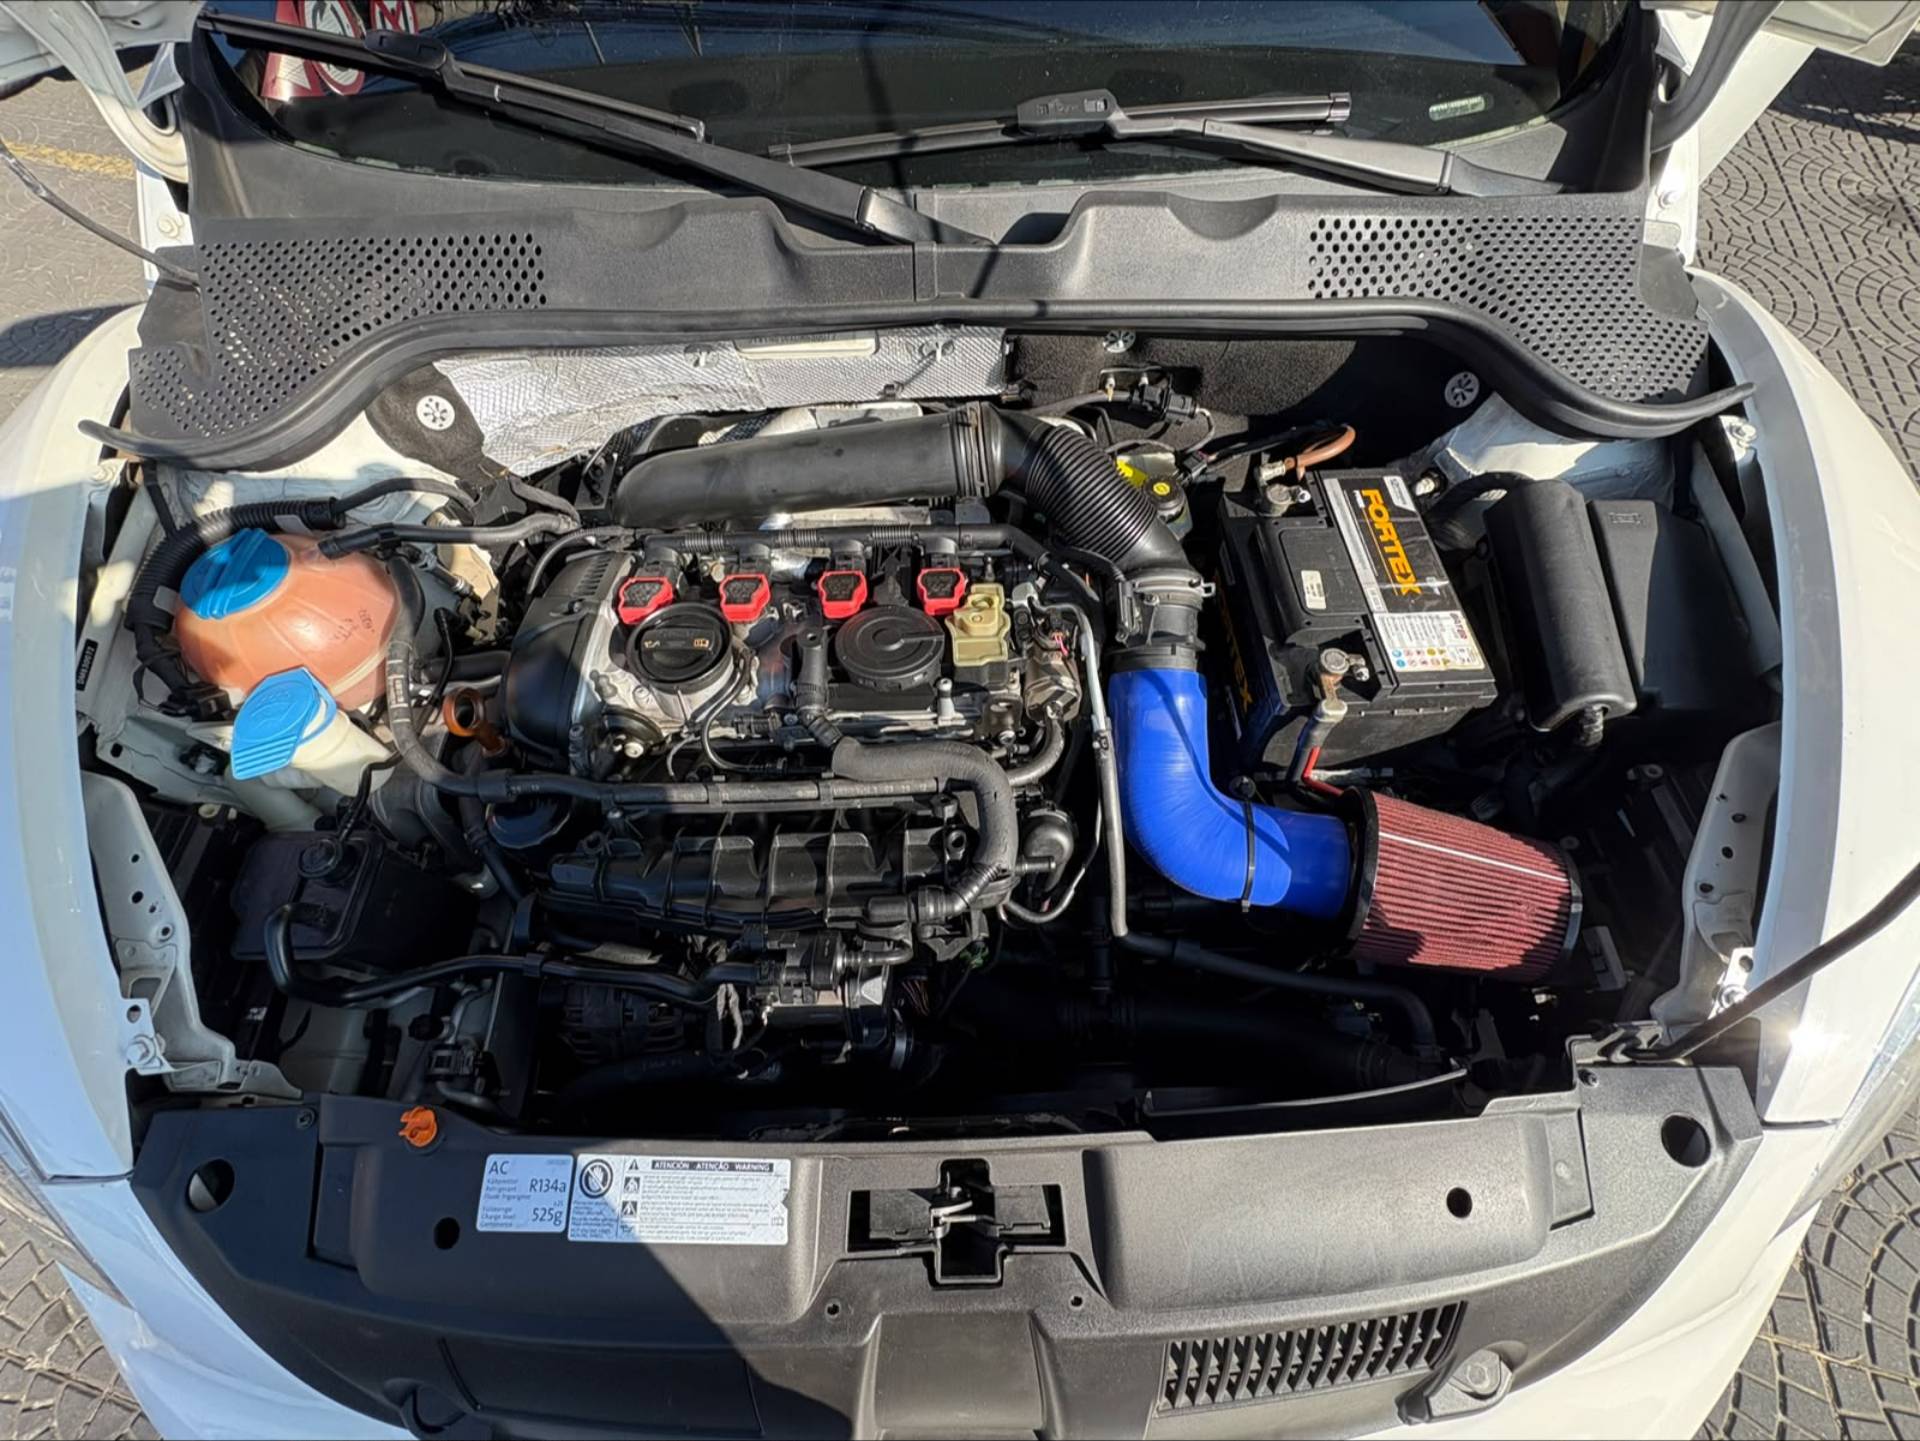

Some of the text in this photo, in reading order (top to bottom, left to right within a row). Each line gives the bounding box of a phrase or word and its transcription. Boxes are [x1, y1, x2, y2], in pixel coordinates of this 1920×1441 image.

[1361, 489, 1422, 595] FORTEX
[489, 1160, 510, 1175] AC
[654, 1160, 770, 1173] ATENCIÓN ATENÇÃO WARNING
[529, 1177, 567, 1193] R134a
[531, 1207, 563, 1227] 525g
